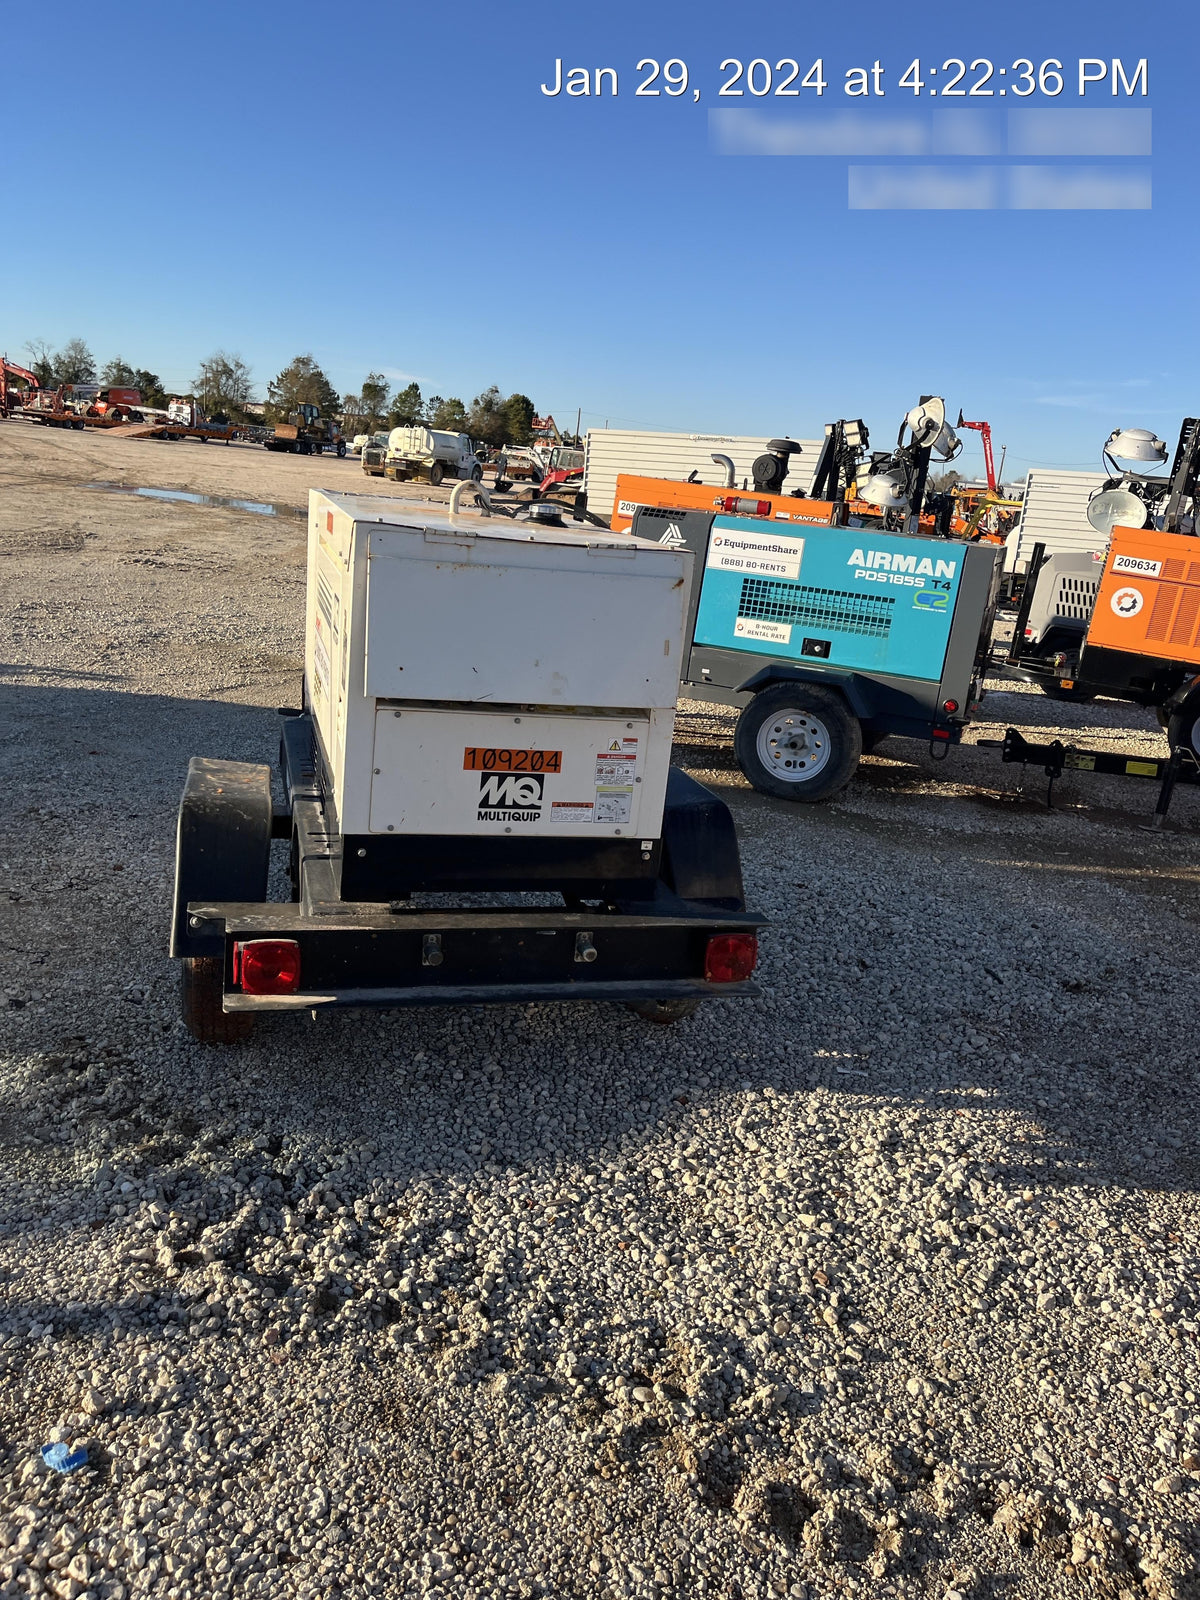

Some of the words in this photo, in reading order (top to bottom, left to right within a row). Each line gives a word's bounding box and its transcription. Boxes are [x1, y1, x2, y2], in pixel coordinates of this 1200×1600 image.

[723, 538, 799, 555] EquipmentShare
[720, 557, 744, 568] (888)
[746, 561, 787, 573] 80-RENTS
[847, 549, 957, 579] AIRMAN
[1116, 557, 1157, 572] 209634
[854, 569, 926, 588] PDS185S
[931, 579, 952, 591] T4
[467, 749, 560, 772] 109204
[480, 775, 541, 806] MQ
[477, 811, 541, 822] MULTIQUIP
